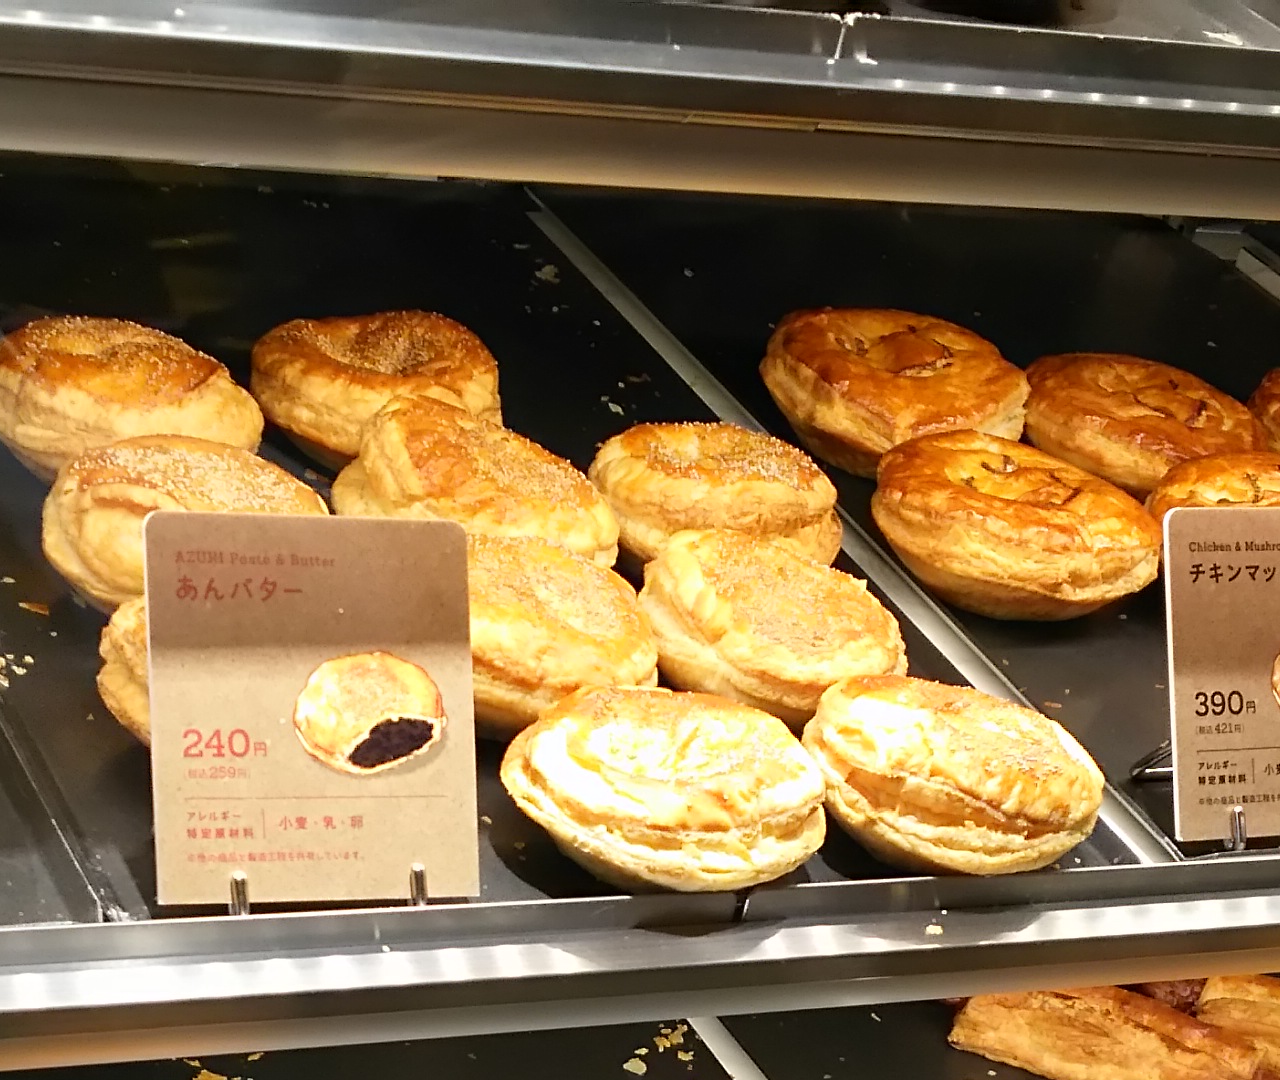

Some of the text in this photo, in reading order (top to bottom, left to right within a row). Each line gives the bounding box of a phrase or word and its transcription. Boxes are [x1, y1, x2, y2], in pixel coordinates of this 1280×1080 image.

[1188, 541, 1233, 552] Chicken
[1234, 541, 1243, 552] &
[290, 554, 336, 568] Butter
[175, 574, 304, 602] あんバター
[1194, 690, 1257, 716] 390円
[182, 728, 268, 759] 240円
[1198, 760, 1238, 771] アレルギー
[186, 811, 242, 822] アレルギー
